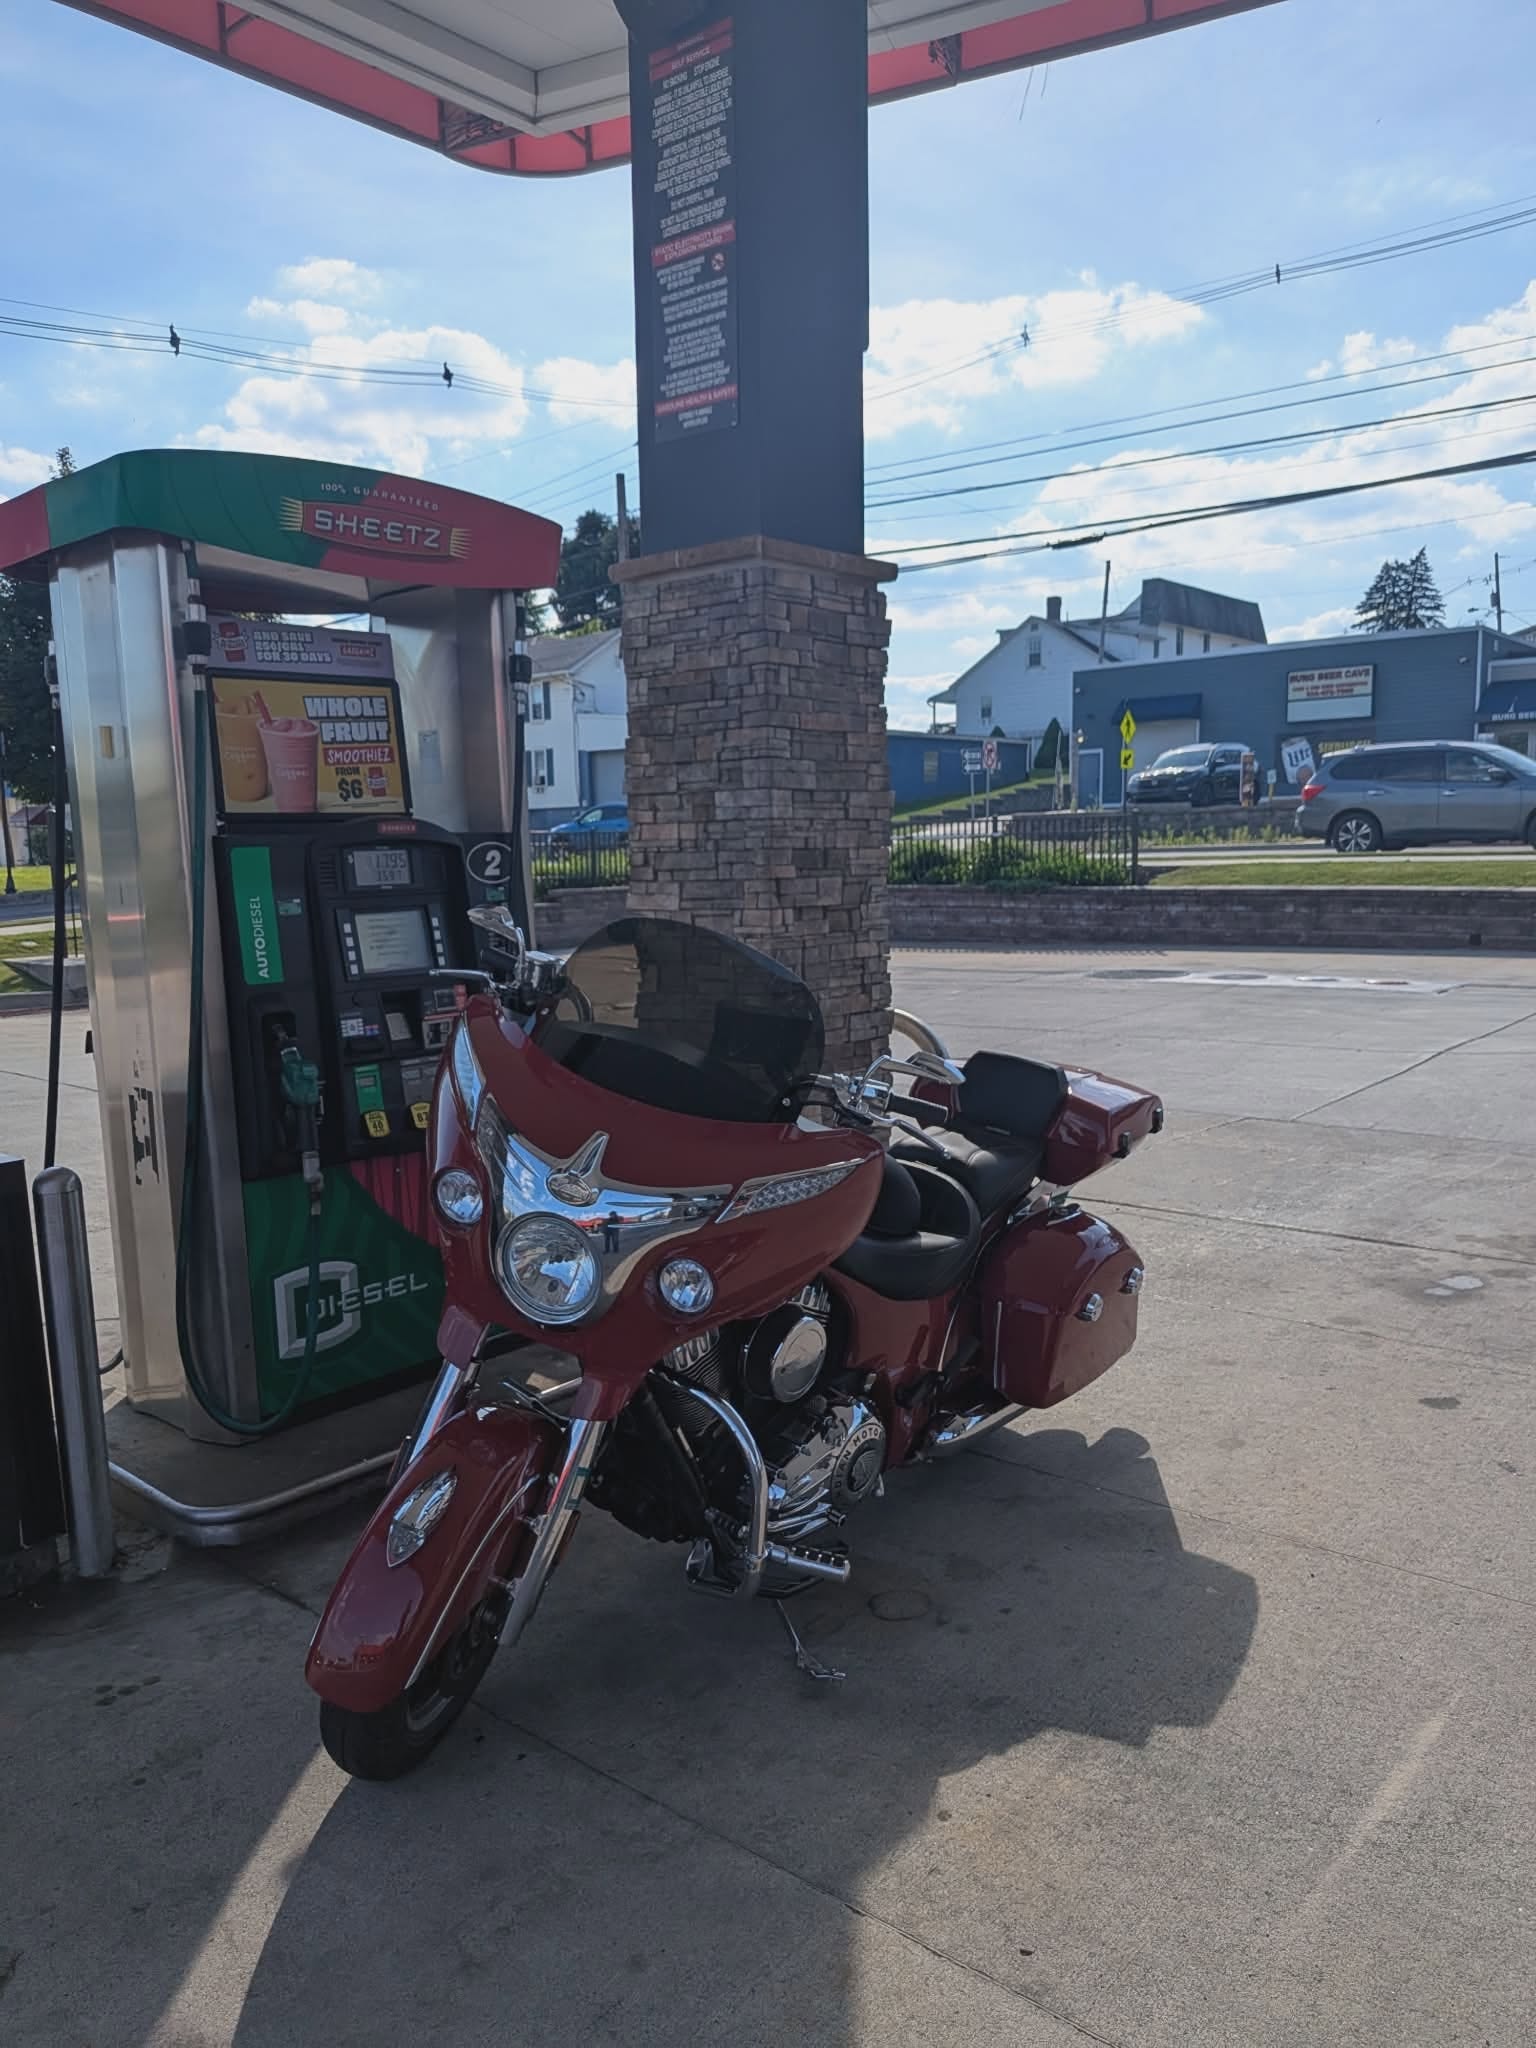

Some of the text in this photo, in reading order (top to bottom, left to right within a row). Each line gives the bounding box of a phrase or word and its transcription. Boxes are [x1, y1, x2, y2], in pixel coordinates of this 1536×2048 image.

[321, 483, 440, 512] 100% GUARANTEED
[314, 509, 441, 549] SHEETZ
[257, 652, 333, 664] FOR 30 DAYS
[1318, 671, 1343, 681] BEER
[1344, 668, 1370, 678] CAVE
[303, 696, 388, 719] WHOLE
[320, 720, 389, 743] FRUIT
[327, 748, 392, 764] SMOOTHIEZ
[335, 766, 360, 777] FROM
[337, 777, 363, 802] $6
[484, 849, 502, 876] 2
[249, 895, 270, 979] AUTODIESEL
[306, 1272, 429, 1320] DIESEL
